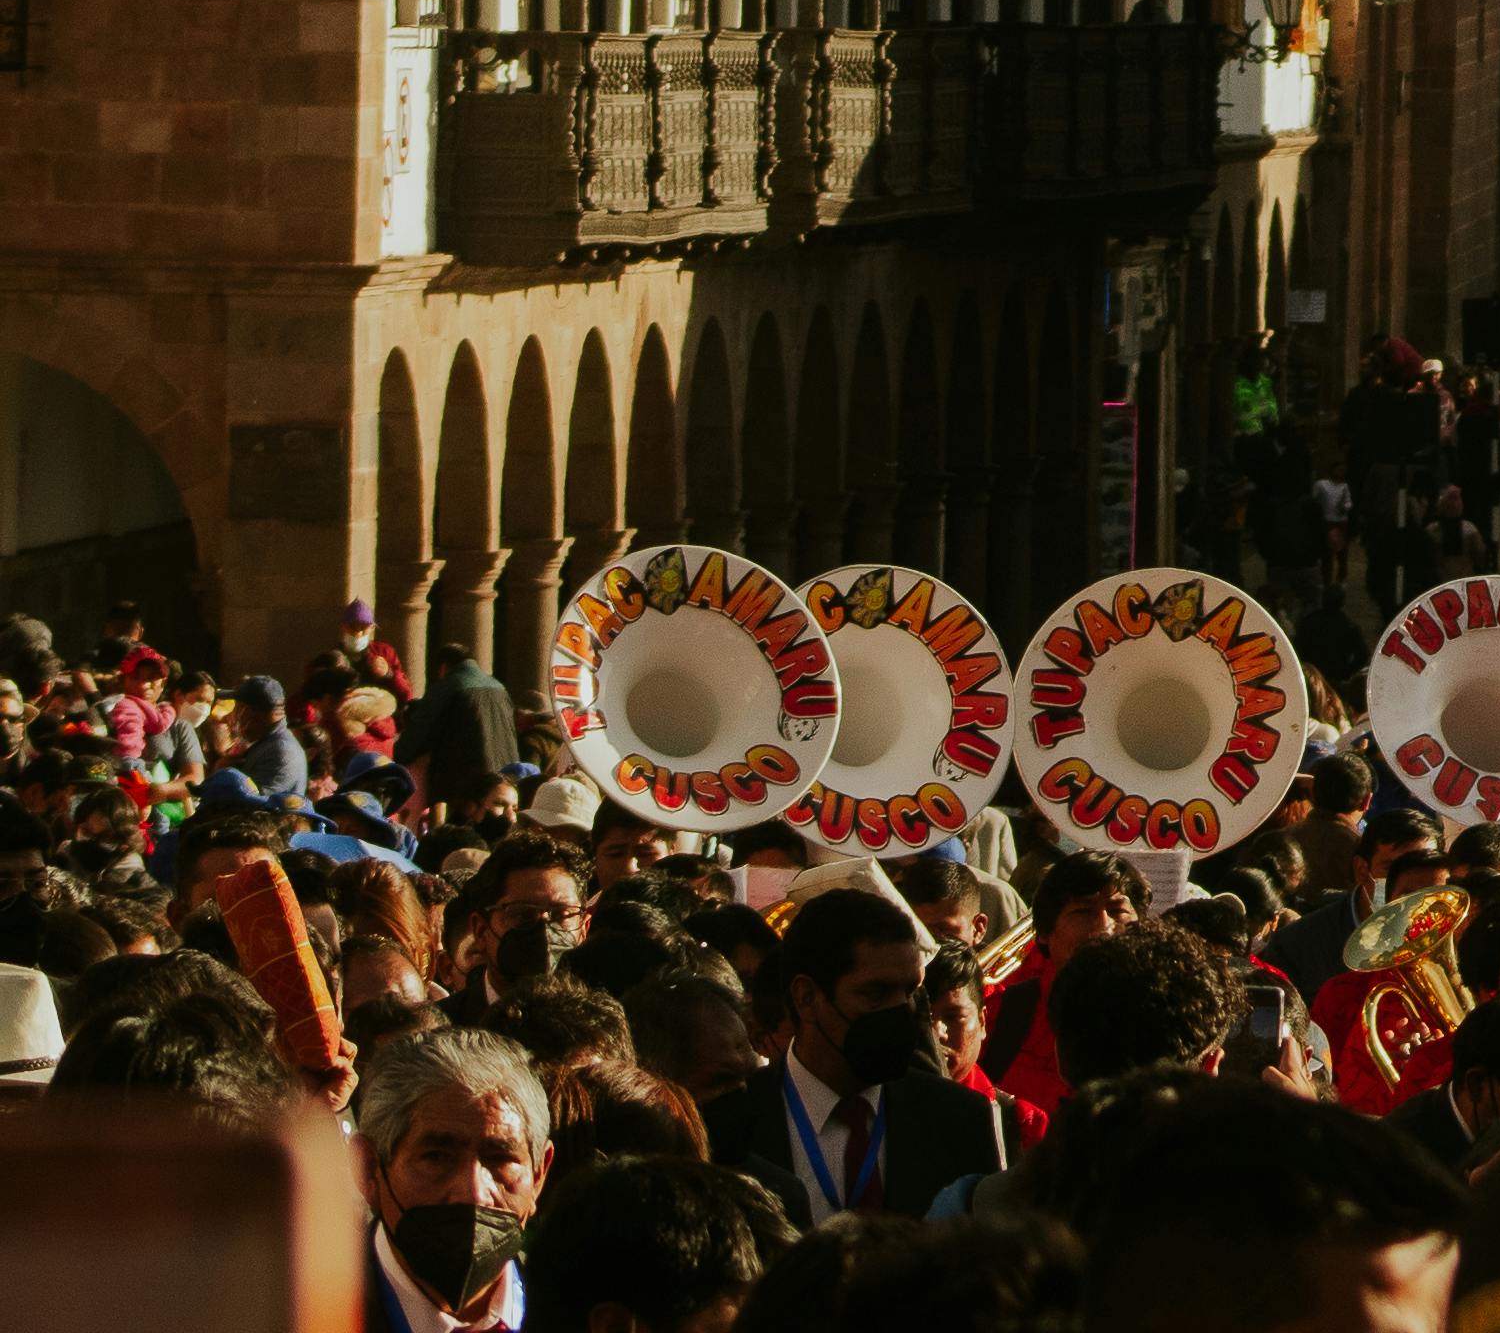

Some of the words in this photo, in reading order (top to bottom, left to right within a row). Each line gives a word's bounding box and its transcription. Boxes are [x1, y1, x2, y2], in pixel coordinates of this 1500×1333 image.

[551, 564, 647, 741] TUPAC
[686, 550, 840, 721] AMARU
[886, 576, 1010, 778] AMARU
[1031, 581, 1154, 750] TUPAC
[1194, 595, 1288, 806] AMARU
[616, 743, 802, 817] CUSCO
[783, 778, 968, 852] CUSCO
[1037, 755, 1222, 853] CUSCO
